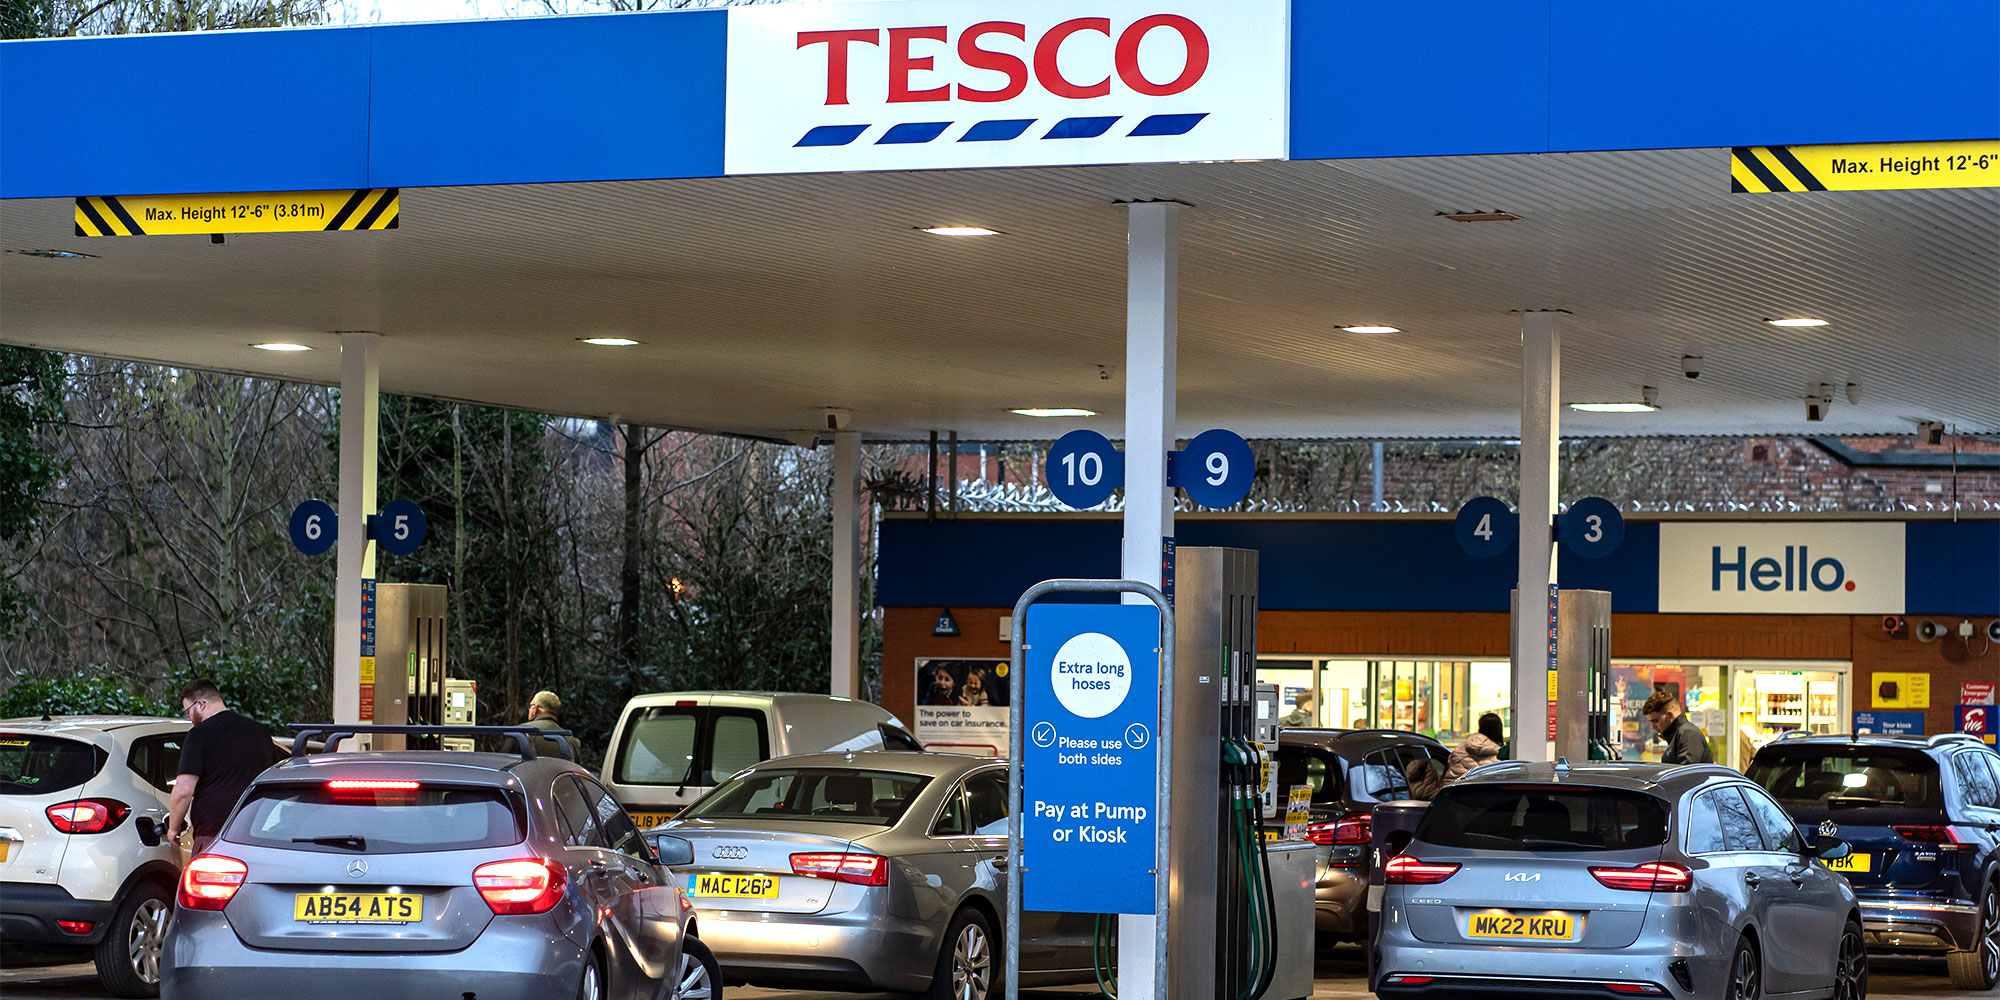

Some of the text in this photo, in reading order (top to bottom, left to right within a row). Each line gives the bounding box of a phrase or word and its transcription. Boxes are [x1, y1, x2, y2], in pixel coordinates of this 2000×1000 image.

[796, 13, 1210, 106] TESCO
[1831, 158, 1874, 174] Max.
[1879, 156, 1940, 176] Height
[145, 206, 177, 221] Max.
[181, 205, 227, 223] Height
[273, 203, 326, 220] (3.81m)
[1061, 451, 1104, 486] 10
[1205, 451, 1230, 487] 9
[305, 514, 322, 540] 6
[393, 515, 410, 540] 5
[1473, 513, 1494, 541] 4
[1584, 514, 1603, 543] 3
[1711, 545, 1857, 593] Hello.
[1058, 661, 1125, 678] Extra long
[1072, 677, 1111, 690] hoses
[920, 709, 971, 719] The power to
[1882, 721, 1912, 729] Your kiosk
[1058, 736, 1123, 750] Please use
[1058, 752, 1123, 766] both sides
[1034, 800, 1147, 824] Pay at Pump
[1052, 825, 1128, 844] or Kiosk
[700, 877, 772, 896] MAC 126P
[304, 896, 413, 917] AB54 ATS
[1475, 916, 1567, 937] MK22 KRU
